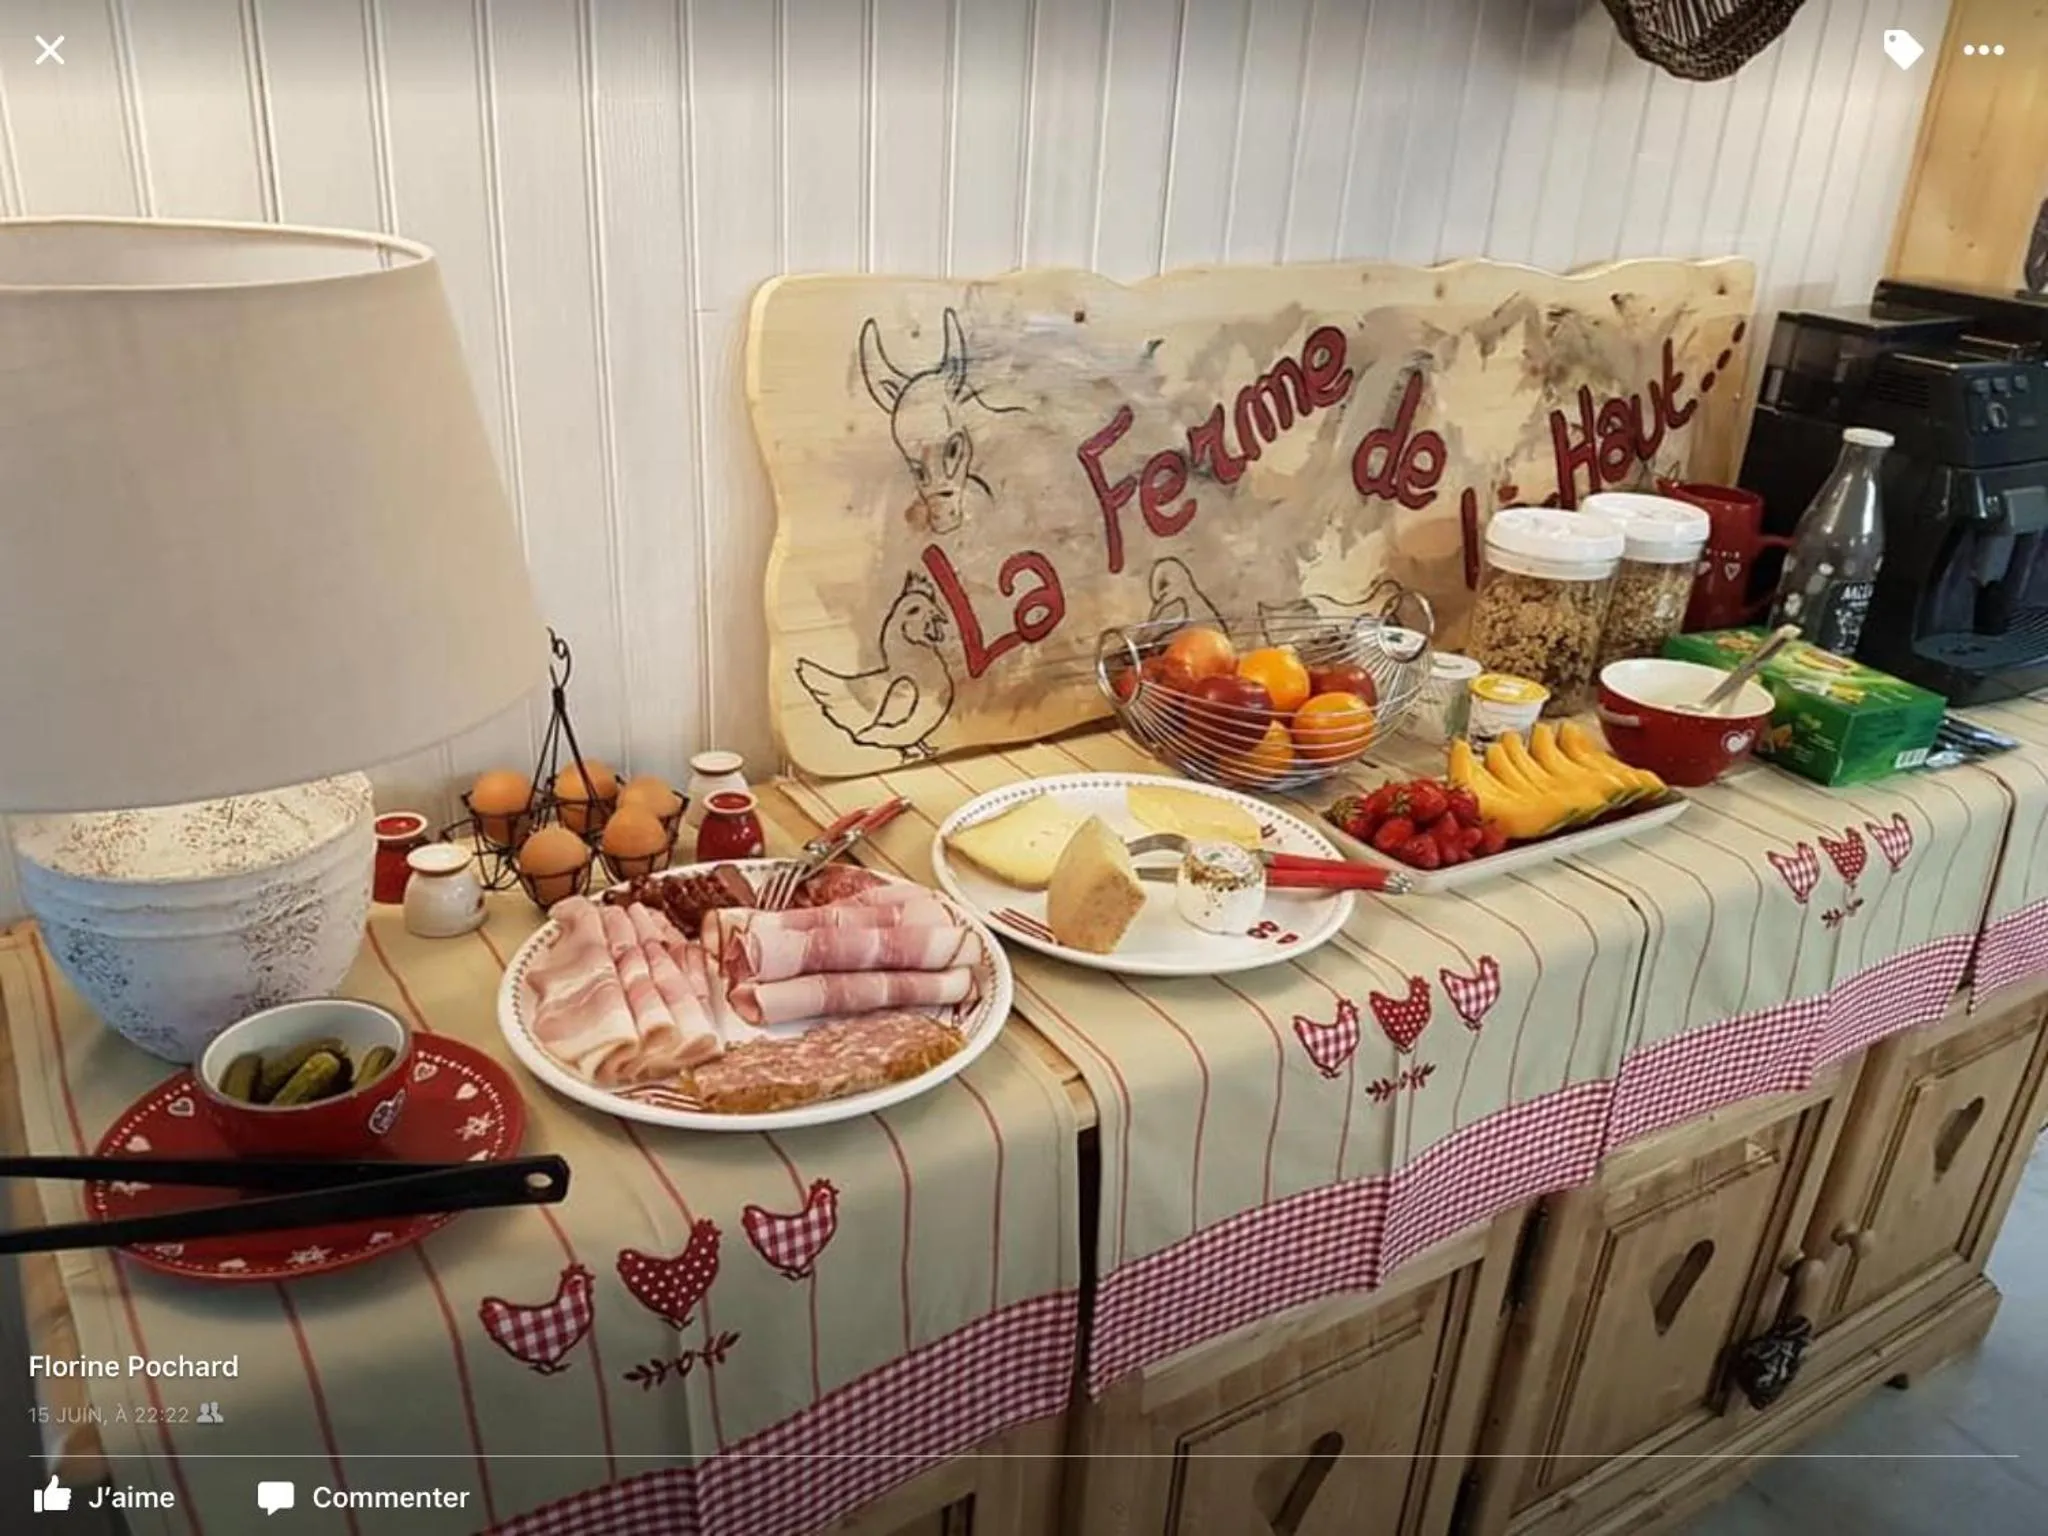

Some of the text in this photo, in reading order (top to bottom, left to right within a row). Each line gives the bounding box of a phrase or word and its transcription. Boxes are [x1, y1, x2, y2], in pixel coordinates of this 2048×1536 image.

[924, 545, 1066, 680] La
[1076, 325, 1354, 574] Ferme
[1351, 368, 1448, 510] de
